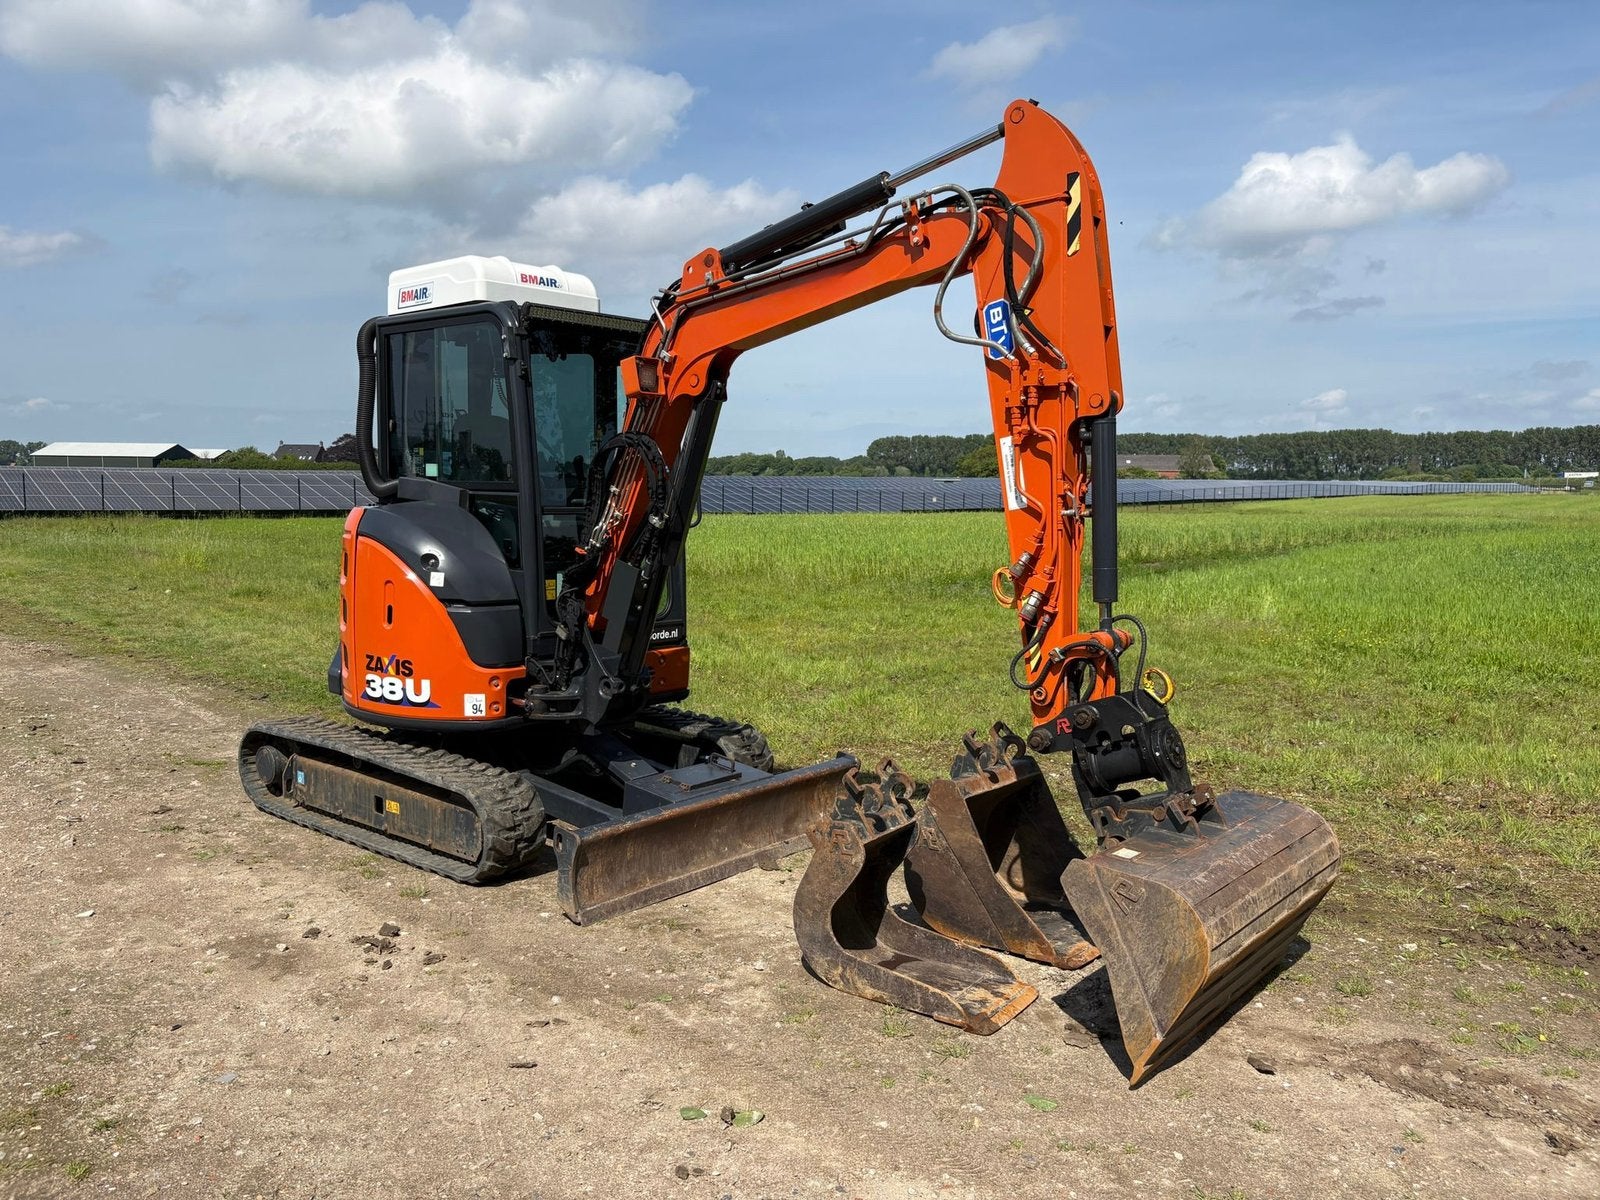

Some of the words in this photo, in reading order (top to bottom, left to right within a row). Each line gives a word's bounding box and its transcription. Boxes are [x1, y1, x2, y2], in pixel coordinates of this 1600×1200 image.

[401, 287, 428, 303] BMAIR
[651, 629, 678, 640] orde.nl
[365, 654, 413, 677] ZAXIS
[365, 674, 431, 707] 38U
[472, 704, 483, 714] 94
